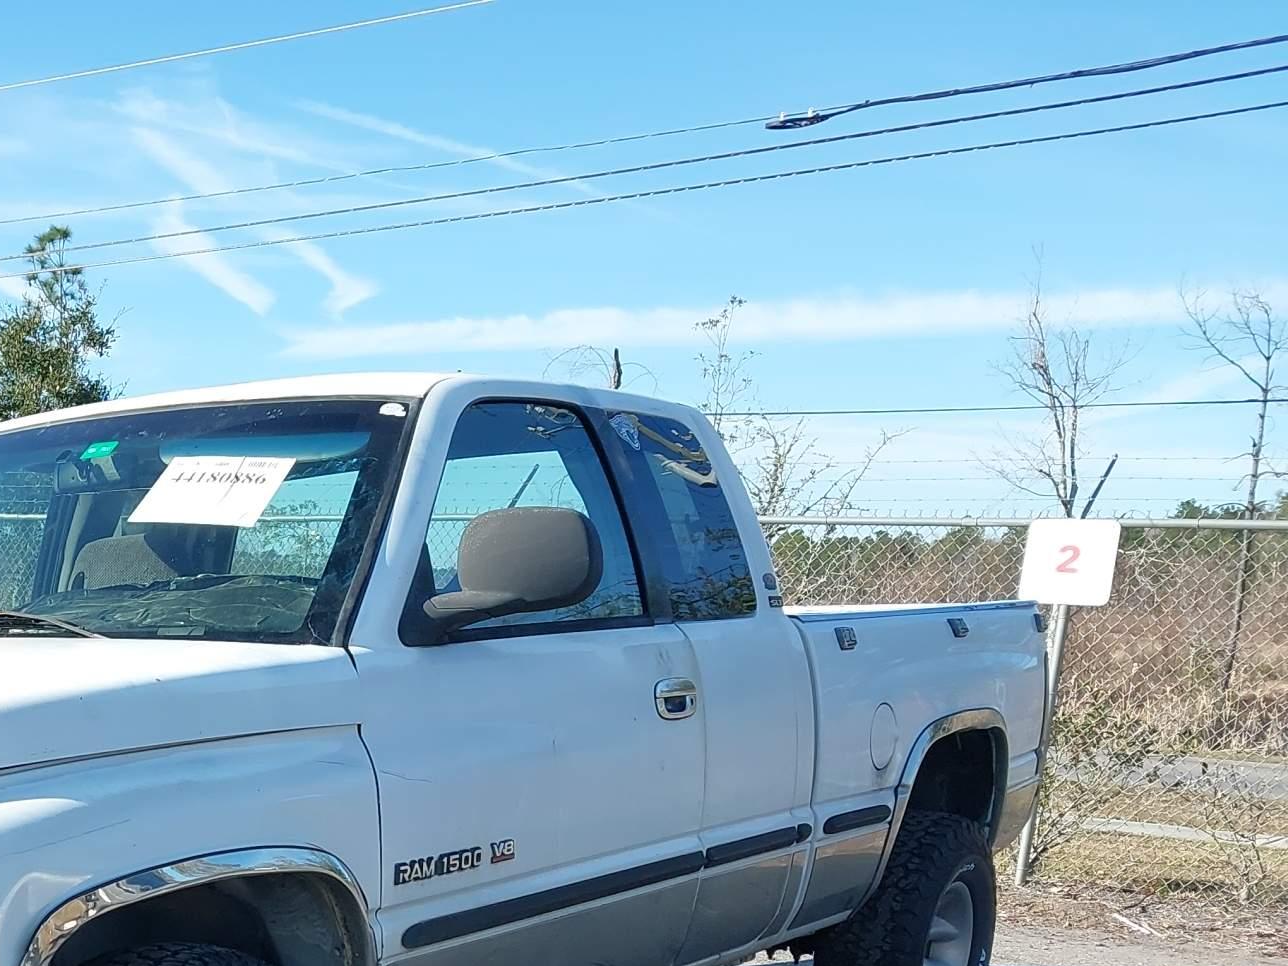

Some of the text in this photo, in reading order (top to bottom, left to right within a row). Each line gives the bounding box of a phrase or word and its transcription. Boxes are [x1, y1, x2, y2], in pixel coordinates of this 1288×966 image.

[171, 471, 267, 485] 44180886
[1055, 545, 1081, 573] 2
[397, 840, 514, 884] RAM 1500 V8
